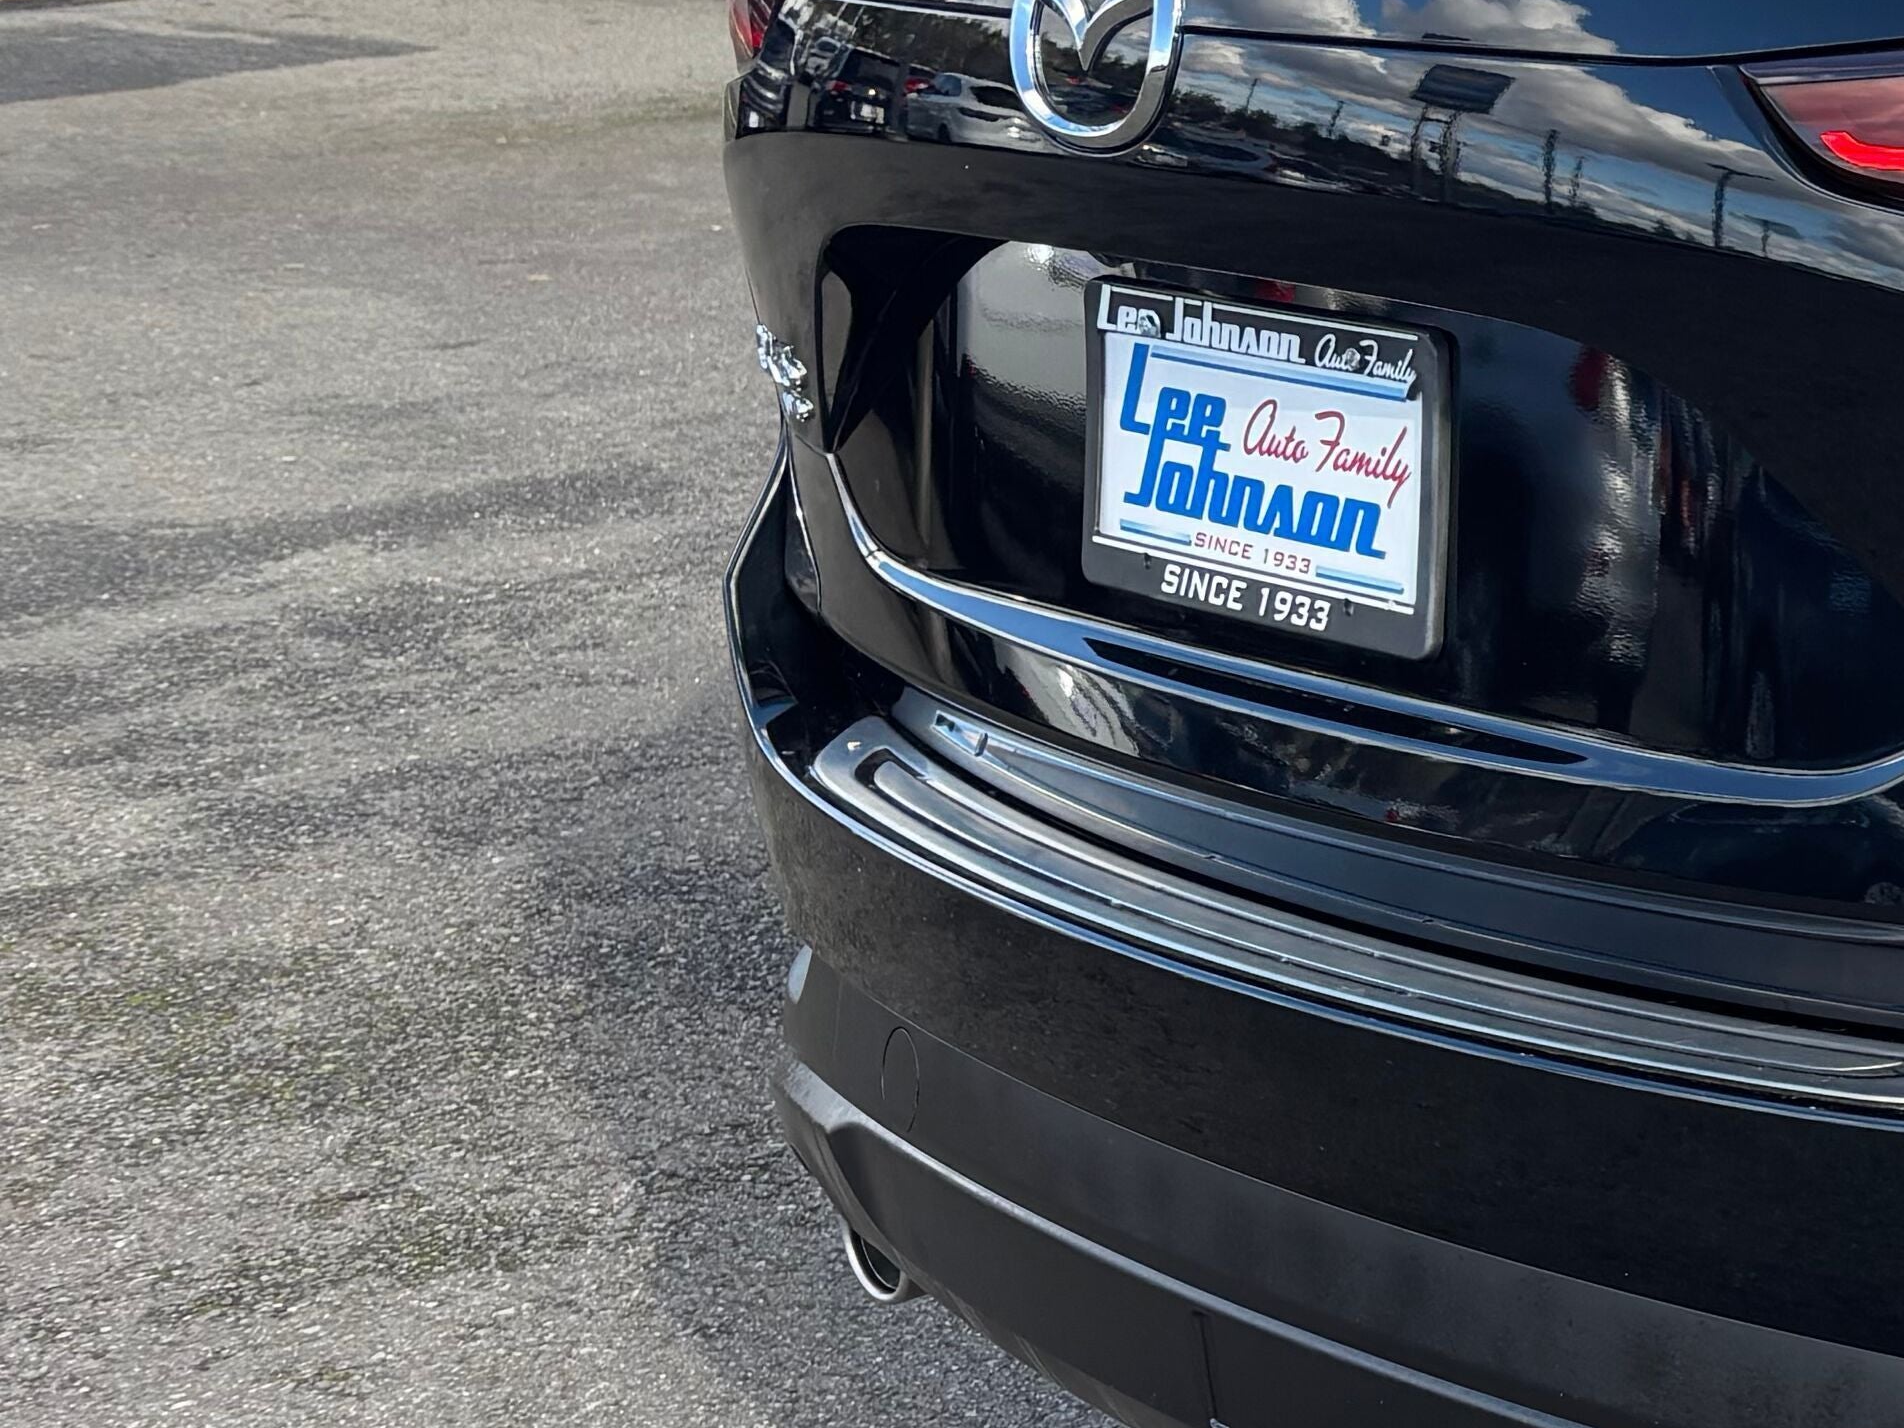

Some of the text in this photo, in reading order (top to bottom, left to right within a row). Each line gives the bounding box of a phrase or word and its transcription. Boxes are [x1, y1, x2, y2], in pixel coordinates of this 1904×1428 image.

[1120, 343, 1230, 451] Lee
[1165, 297, 1306, 364] Johnson
[1315, 334, 1360, 371] Aut
[1359, 339, 1417, 398] Family
[1123, 424, 1387, 559] Johnson
[1243, 399, 1412, 509] Auto Family
[1160, 563, 1332, 632] SINCE 1933
[1194, 532, 1312, 574] SINCE 1933
